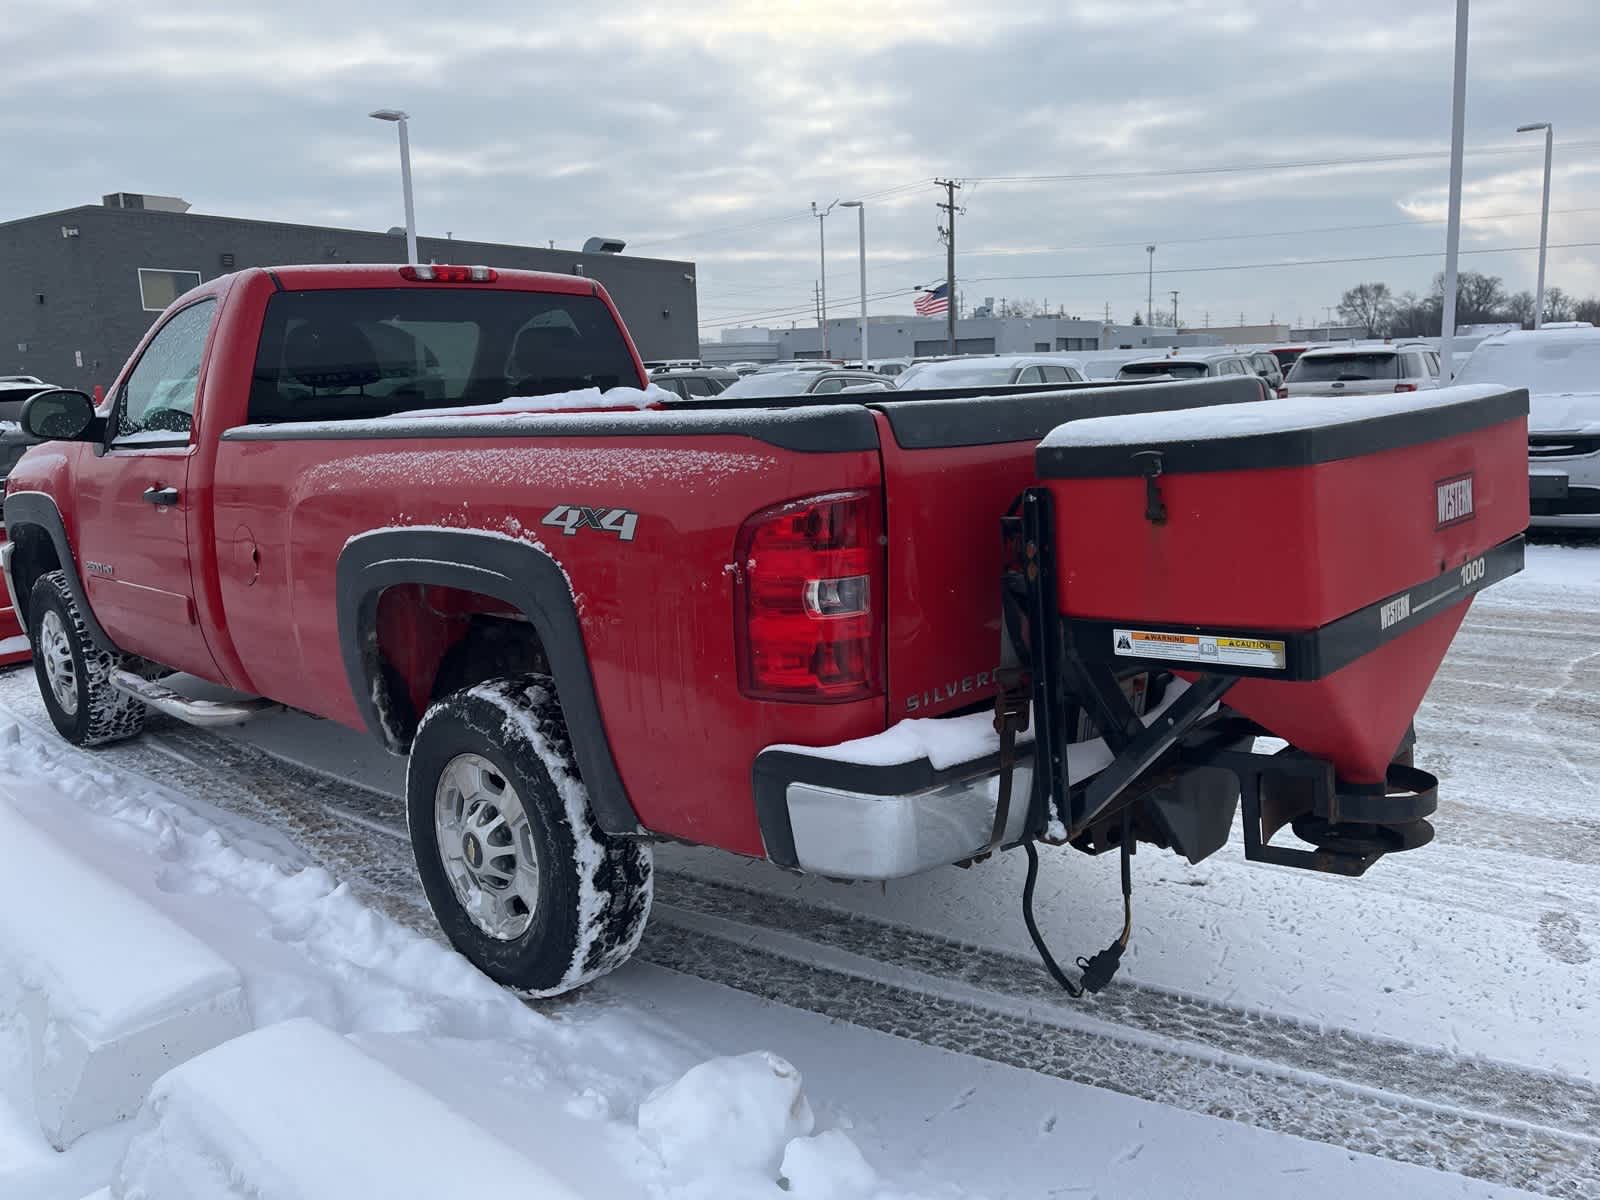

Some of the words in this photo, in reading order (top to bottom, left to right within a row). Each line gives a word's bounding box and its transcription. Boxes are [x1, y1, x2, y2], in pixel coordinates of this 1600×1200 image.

[1437, 477, 1474, 524] WESTERN
[1380, 593, 1411, 632] WESTERN
[1460, 557, 1486, 587] 1000
[1150, 634, 1186, 644] WARNING
[1235, 641, 1272, 650] CAUTION
